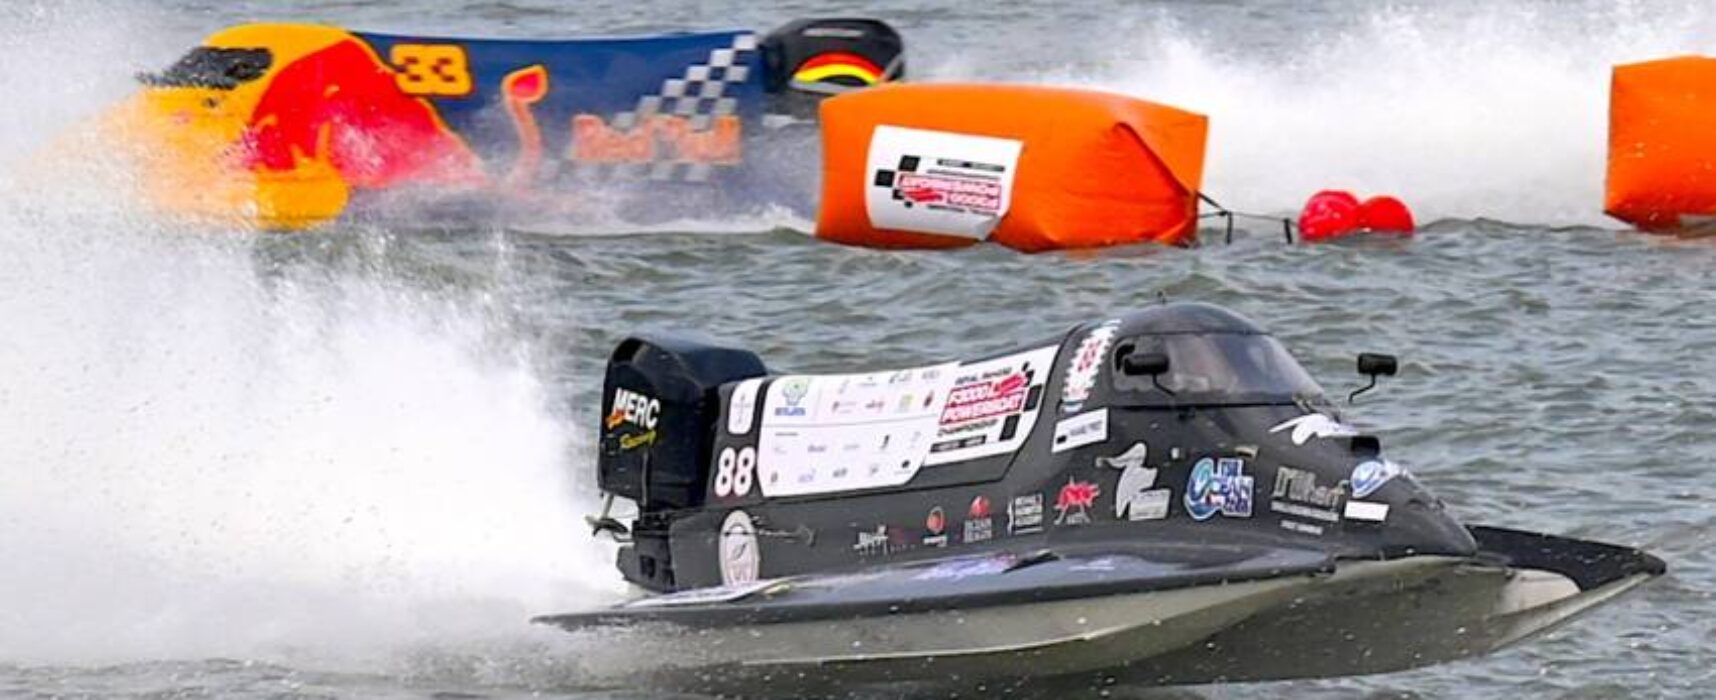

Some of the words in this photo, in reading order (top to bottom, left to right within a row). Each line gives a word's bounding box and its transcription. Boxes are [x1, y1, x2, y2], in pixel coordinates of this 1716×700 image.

[389, 43, 472, 95] 33
[573, 113, 653, 162] Red
[610, 386, 660, 430] MERC
[714, 446, 756, 497] 88
